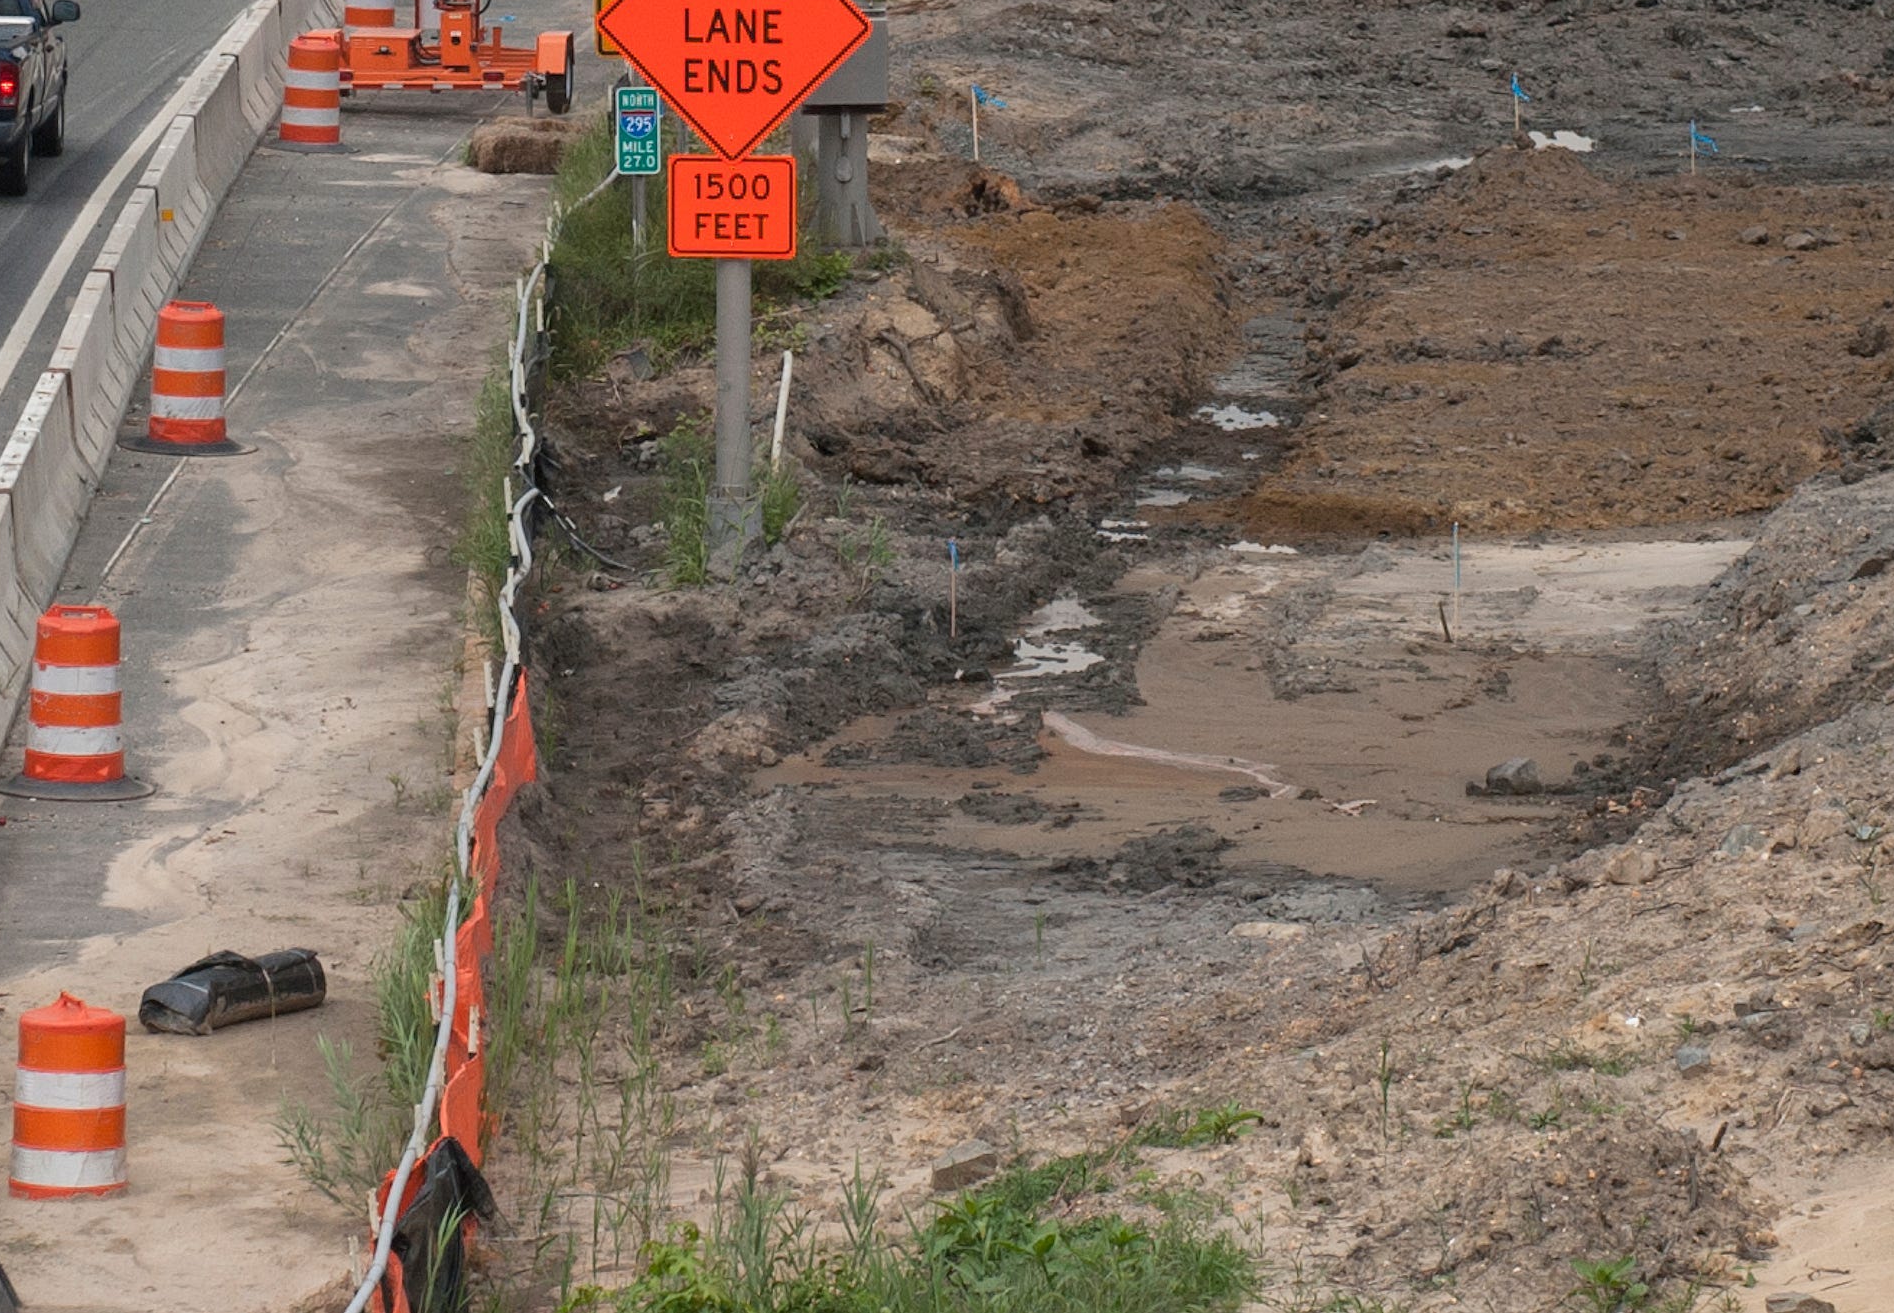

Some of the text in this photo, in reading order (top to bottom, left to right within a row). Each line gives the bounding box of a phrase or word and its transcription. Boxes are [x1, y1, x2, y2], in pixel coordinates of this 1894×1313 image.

[684, 8, 784, 44] LANE
[684, 59, 784, 95] ENDS
[622, 93, 654, 107] NORTH
[626, 116, 653, 133] 295
[622, 141, 654, 153] MILE
[623, 156, 656, 168] 27.0
[694, 173, 771, 200] 1500
[695, 213, 770, 241] FEET
